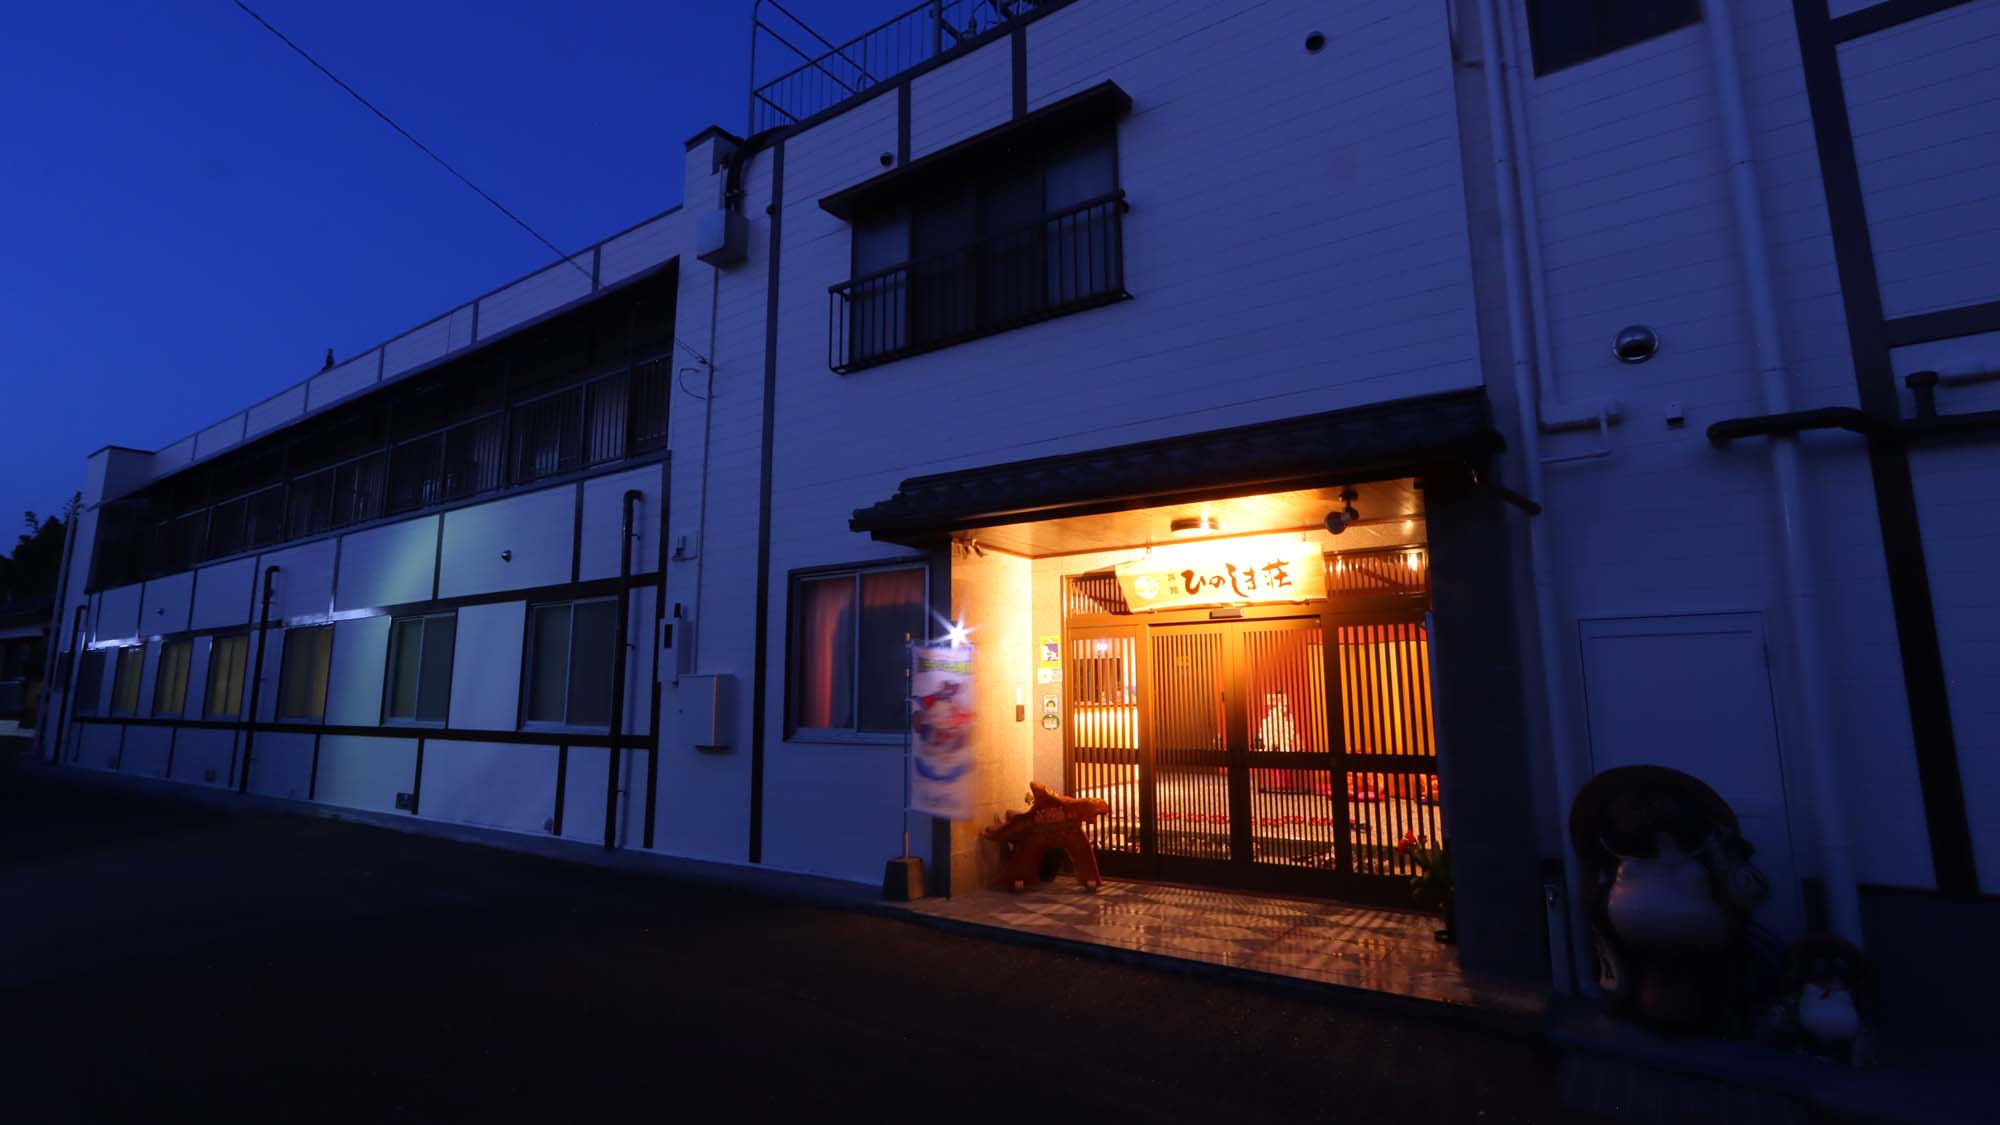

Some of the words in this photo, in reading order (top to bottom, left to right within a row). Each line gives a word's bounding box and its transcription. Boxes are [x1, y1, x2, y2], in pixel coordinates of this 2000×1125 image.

[1180, 558, 1293, 598] ひのしま荘
